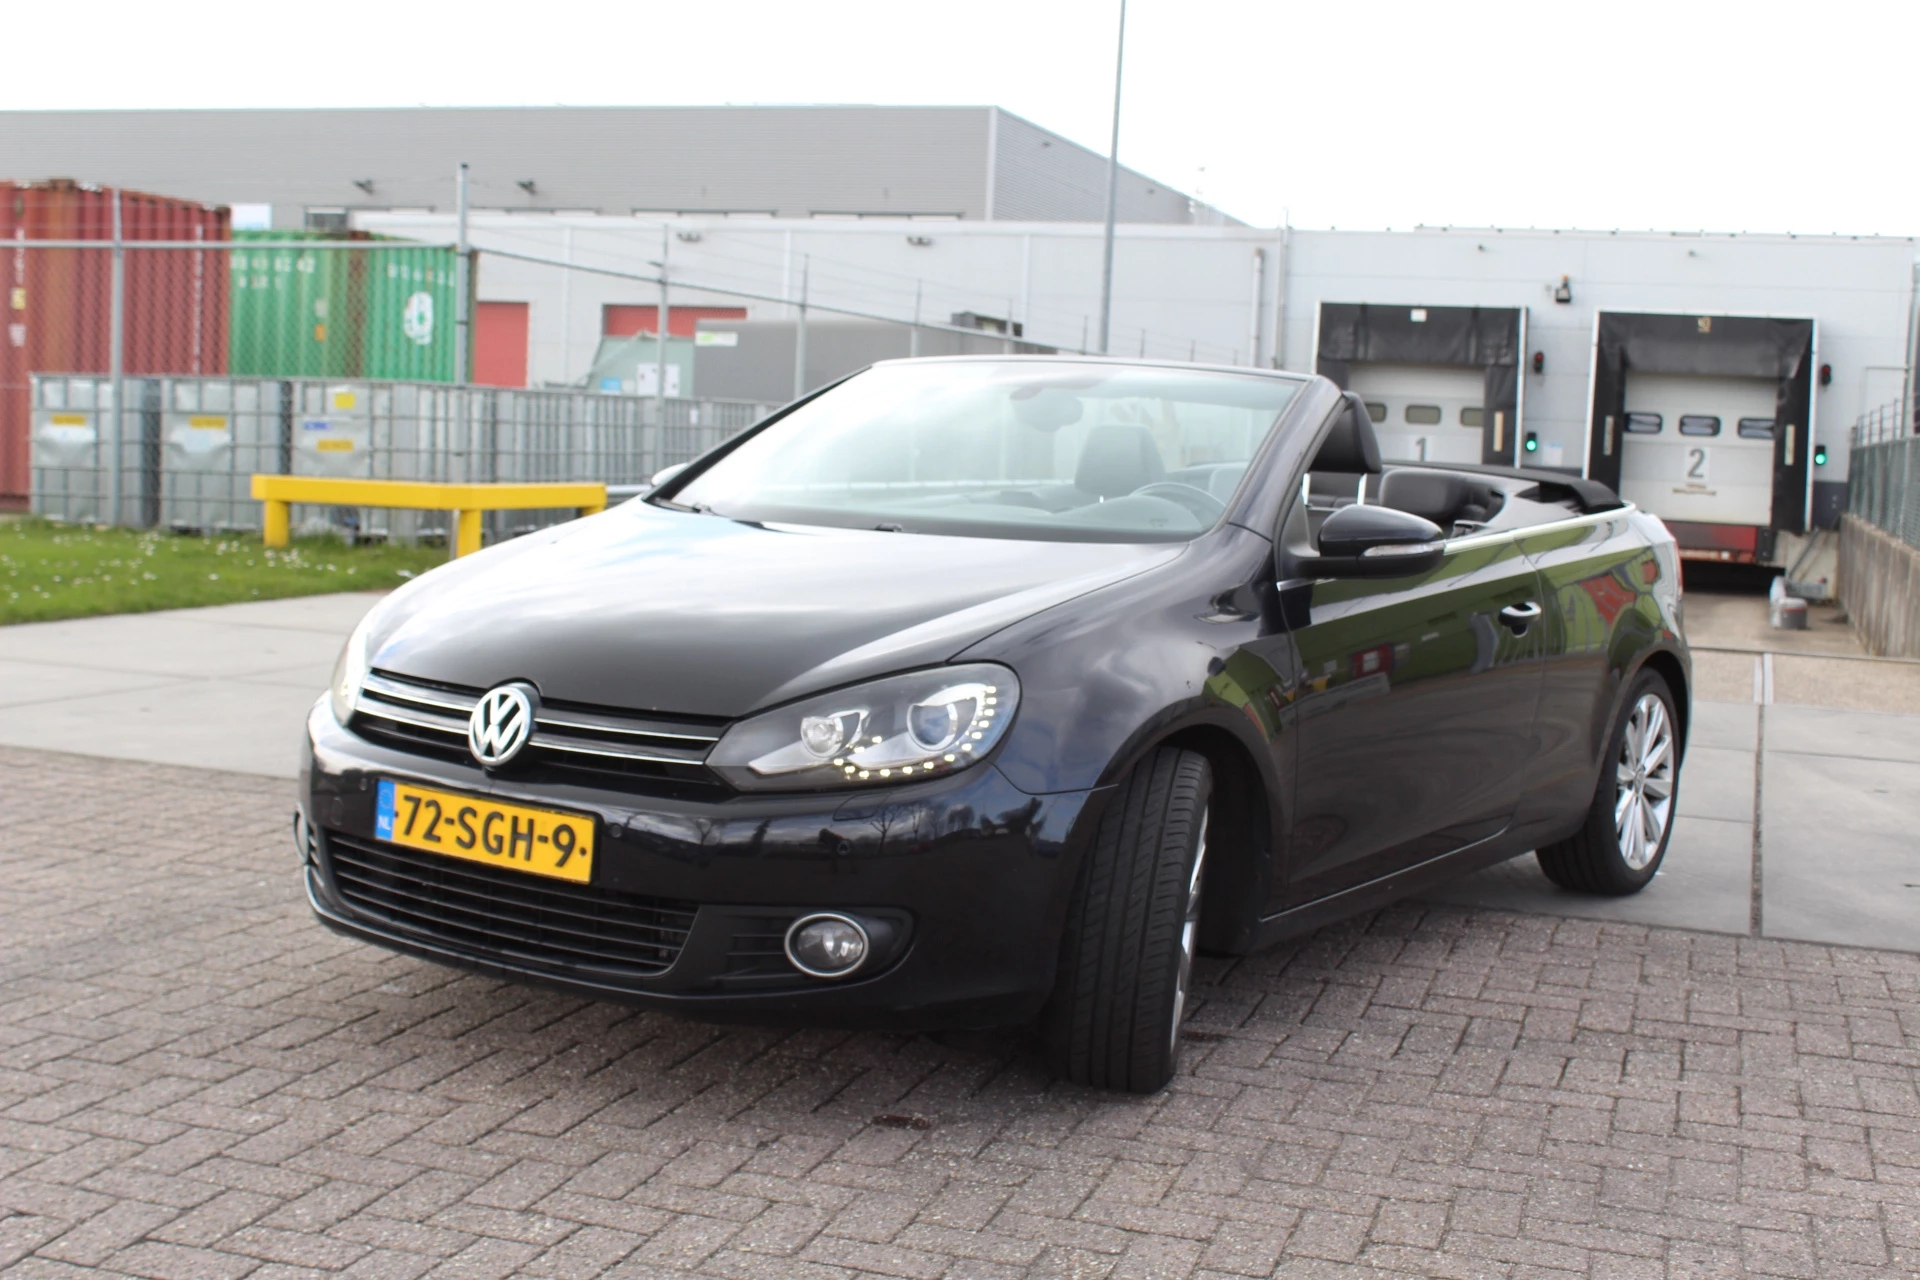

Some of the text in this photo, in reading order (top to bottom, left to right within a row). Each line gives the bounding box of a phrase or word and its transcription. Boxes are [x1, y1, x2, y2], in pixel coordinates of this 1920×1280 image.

[1415, 437, 1426, 462] 1
[1688, 448, 1705, 478] 2
[472, 690, 527, 762] VW
[377, 814, 391, 831] NL
[402, 794, 577, 868] 72-SGH-9
